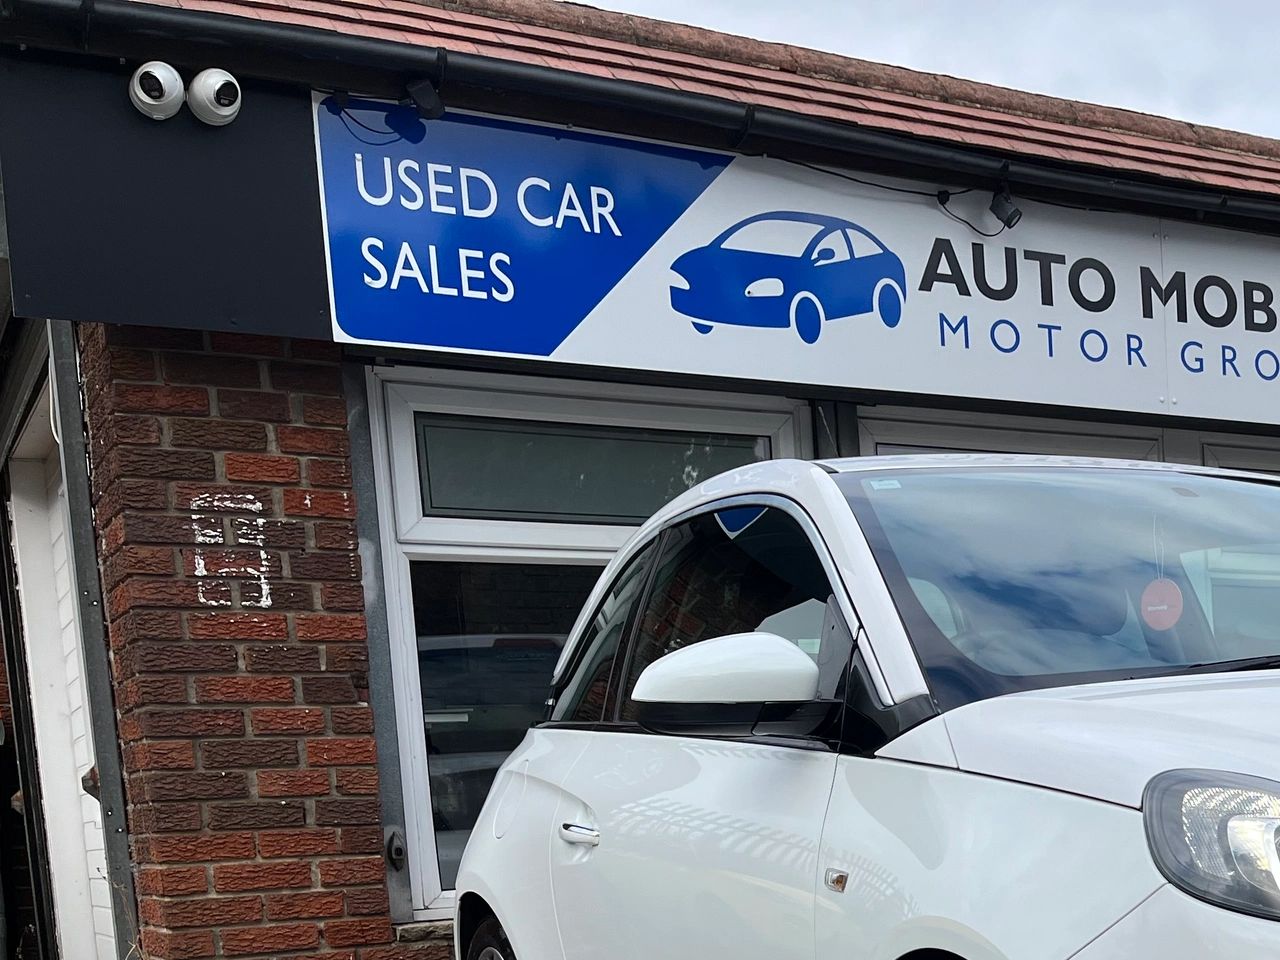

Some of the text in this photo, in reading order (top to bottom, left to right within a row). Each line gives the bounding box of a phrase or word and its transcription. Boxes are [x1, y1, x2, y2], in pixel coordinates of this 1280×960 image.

[354, 153, 623, 237] USED CAR
[360, 237, 515, 302] SALES
[918, 237, 1116, 313] AUTO
[938, 313, 1147, 367] MOTOR
